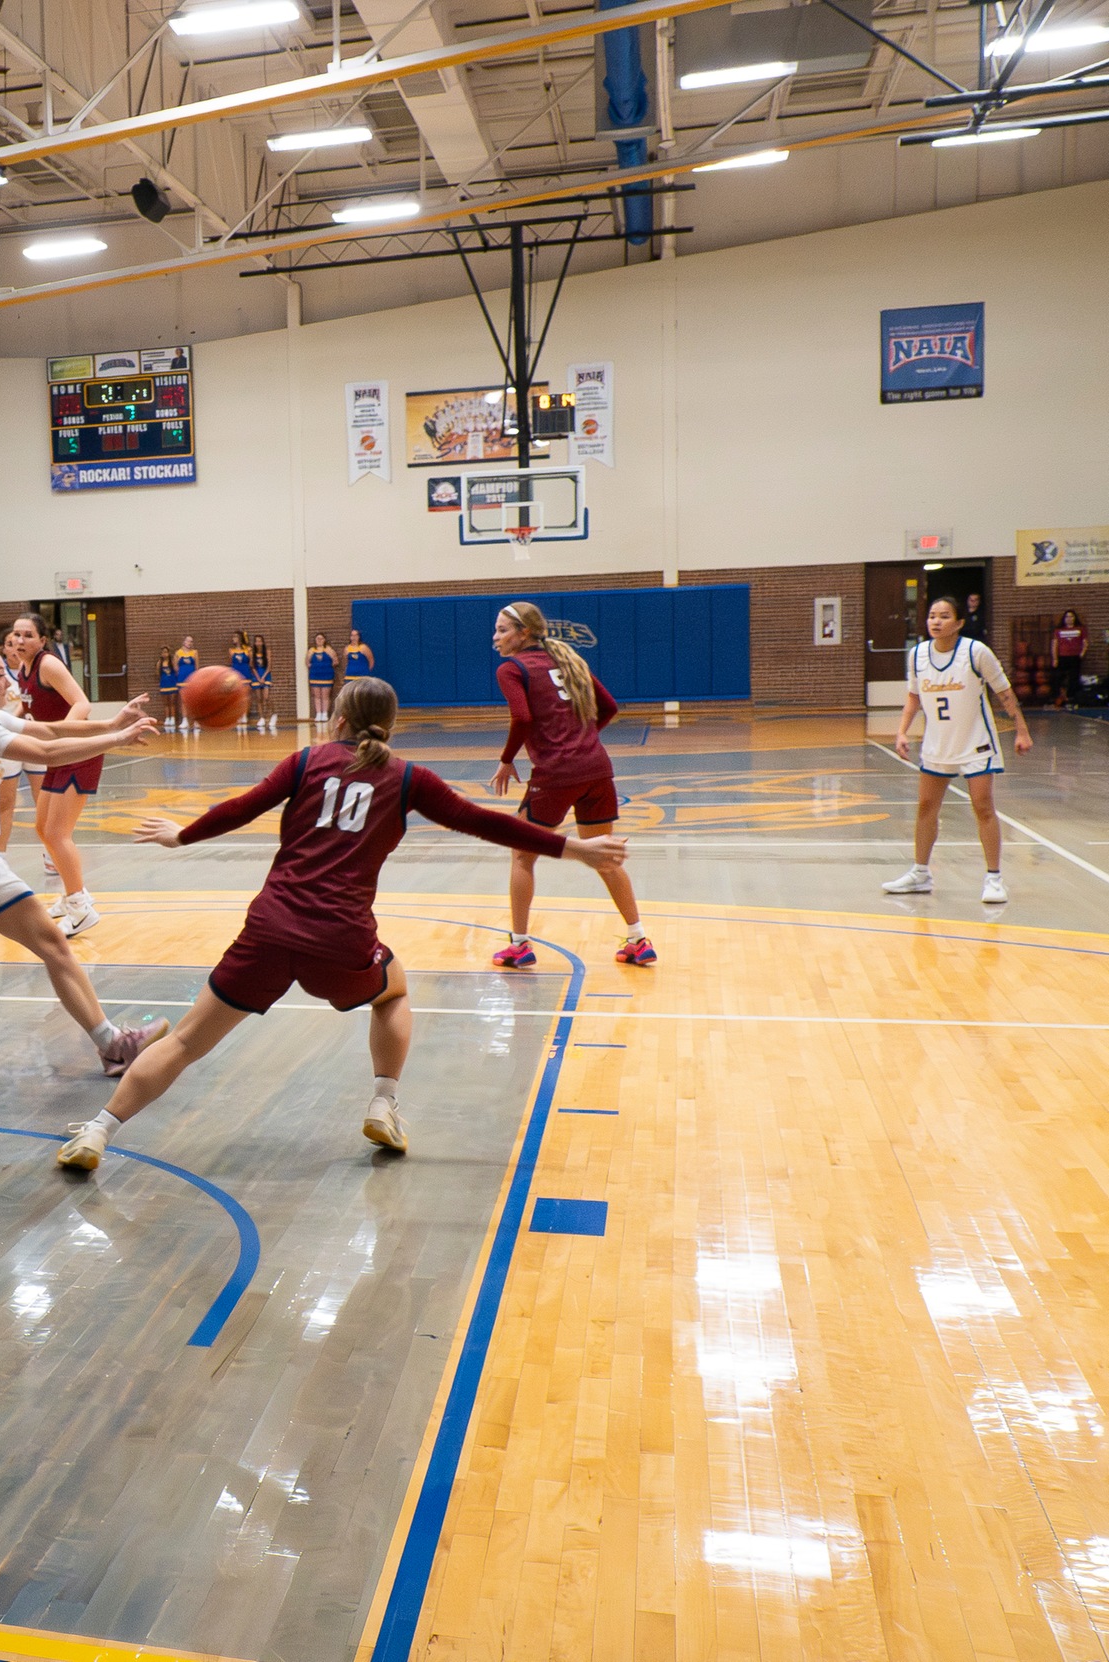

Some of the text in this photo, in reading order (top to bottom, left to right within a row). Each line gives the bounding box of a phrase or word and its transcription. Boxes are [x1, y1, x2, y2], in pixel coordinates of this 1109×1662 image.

[891, 334, 973, 367] NAIA
[155, 375, 188, 387] VISITOR
[52, 384, 82, 395] HOME
[98, 425, 123, 436] PLAYER
[162, 420, 184, 430] FOULS
[58, 428, 80, 438] FOULS
[79, 463, 194, 484] ROCKAR! STOCKAR!
[936, 697, 951, 721] 2
[314, 776, 375, 833] 10
